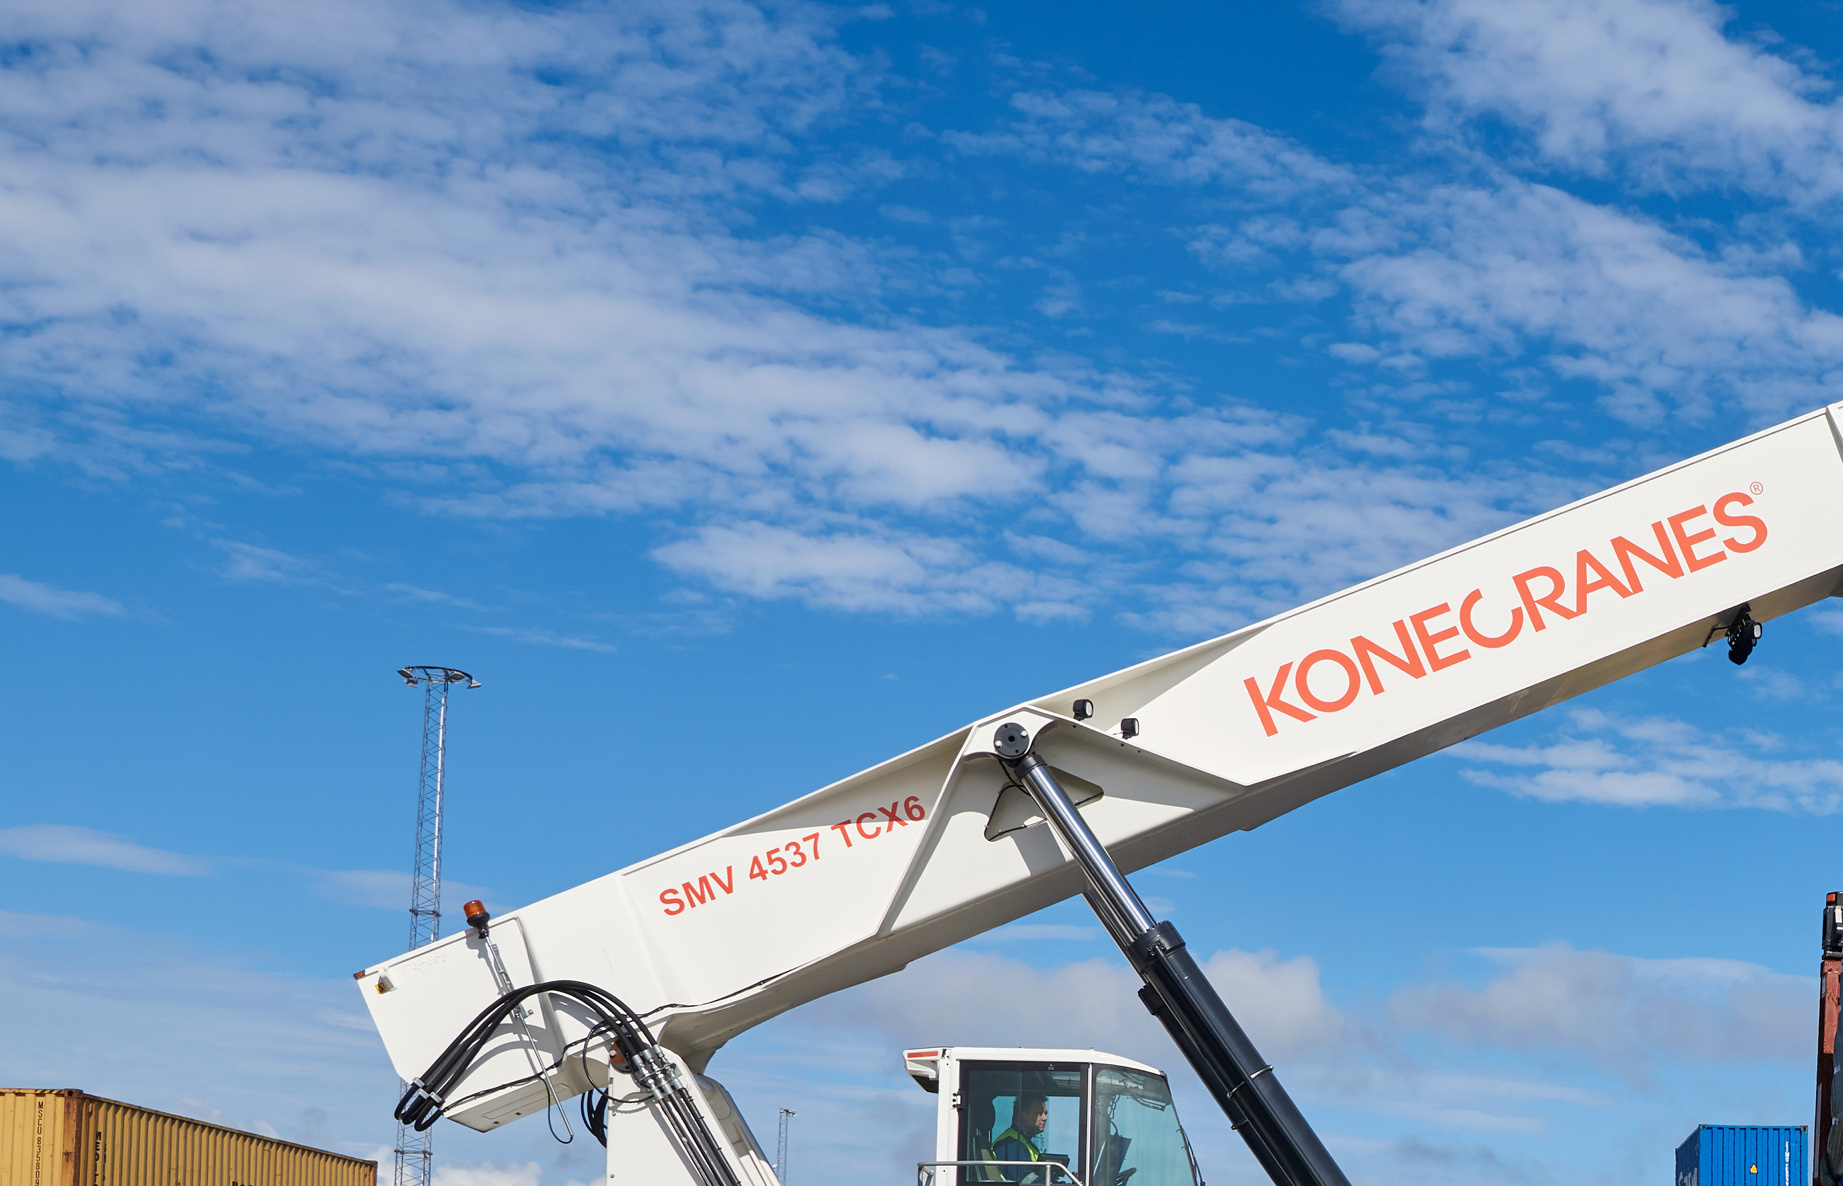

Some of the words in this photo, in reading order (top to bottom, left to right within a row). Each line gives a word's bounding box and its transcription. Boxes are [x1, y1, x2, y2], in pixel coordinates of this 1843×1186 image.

[1243, 491, 1768, 737] KONECRANES
[659, 864, 735, 917] SMV
[748, 831, 821, 882] 4537
[830, 795, 926, 848] TCX6
